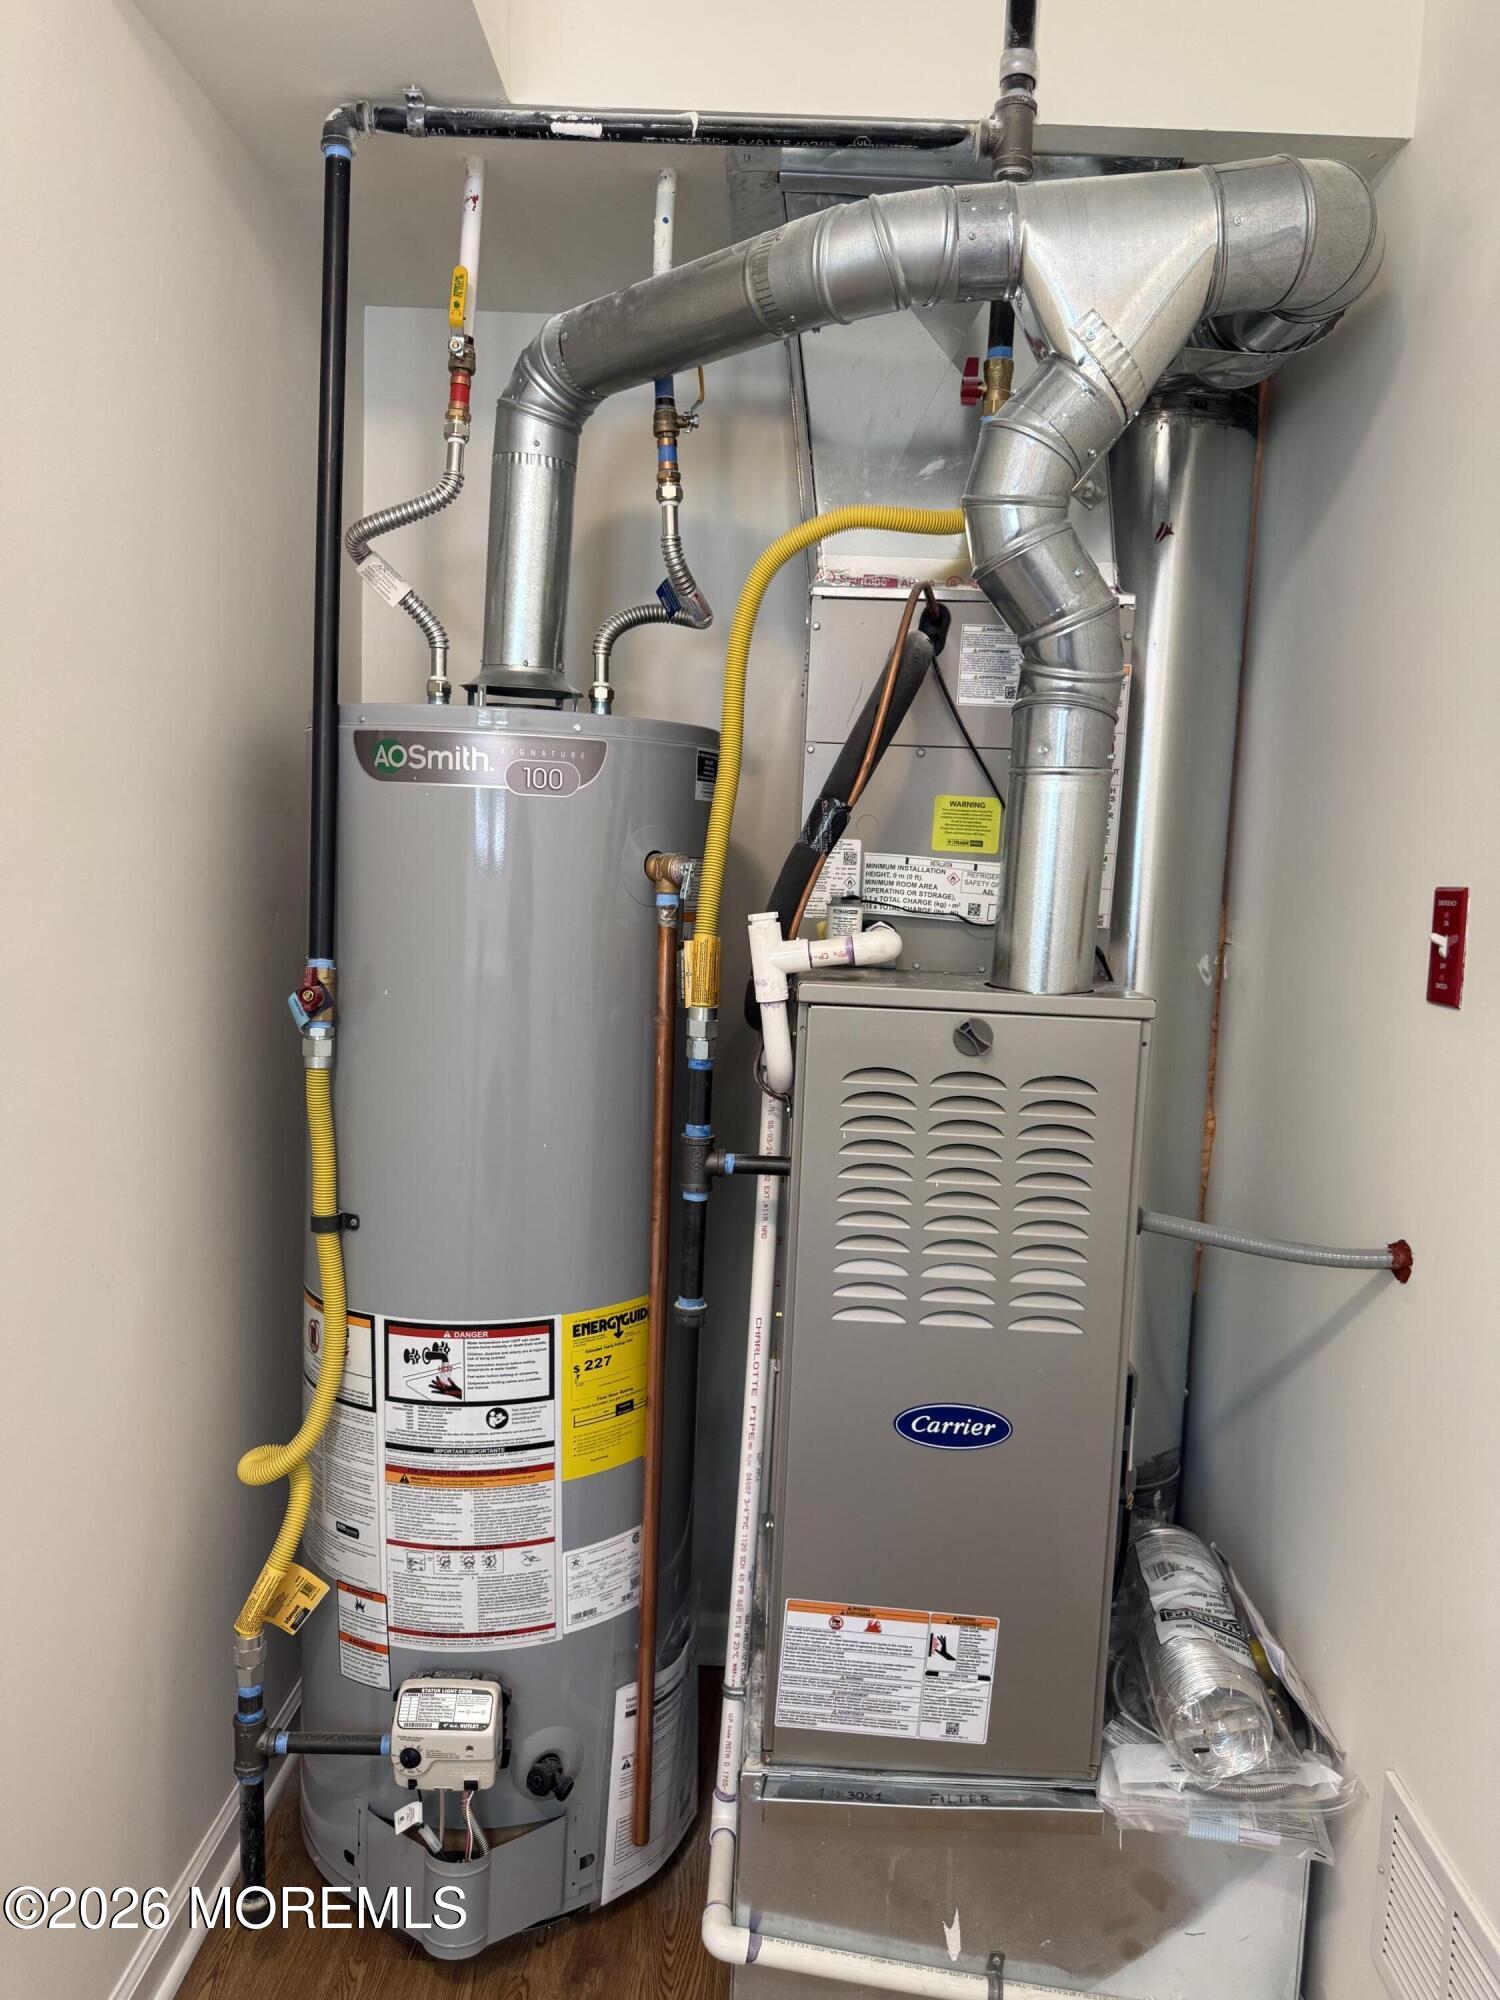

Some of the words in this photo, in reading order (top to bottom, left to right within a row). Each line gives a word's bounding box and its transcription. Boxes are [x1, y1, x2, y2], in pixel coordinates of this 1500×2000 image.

[500, 747, 585, 760] SIGNATURE
[523, 767, 564, 790] 100
[950, 800, 986, 808] WARNING
[897, 864, 946, 875] INSTALLATION
[964, 880, 989, 888] SAFETY
[864, 887, 905, 896] (OPERATING
[902, 897, 932, 906] CHARGE
[934, 899, 946, 908] (kg)
[454, 1330, 489, 1339] DANGER
[751, 1316, 763, 1396] CHARLOTTE
[573, 1364, 580, 1374] $
[584, 1354, 612, 1371] 227
[911, 1415, 997, 1436] Carrier
[929, 1793, 991, 1804] FILTER
